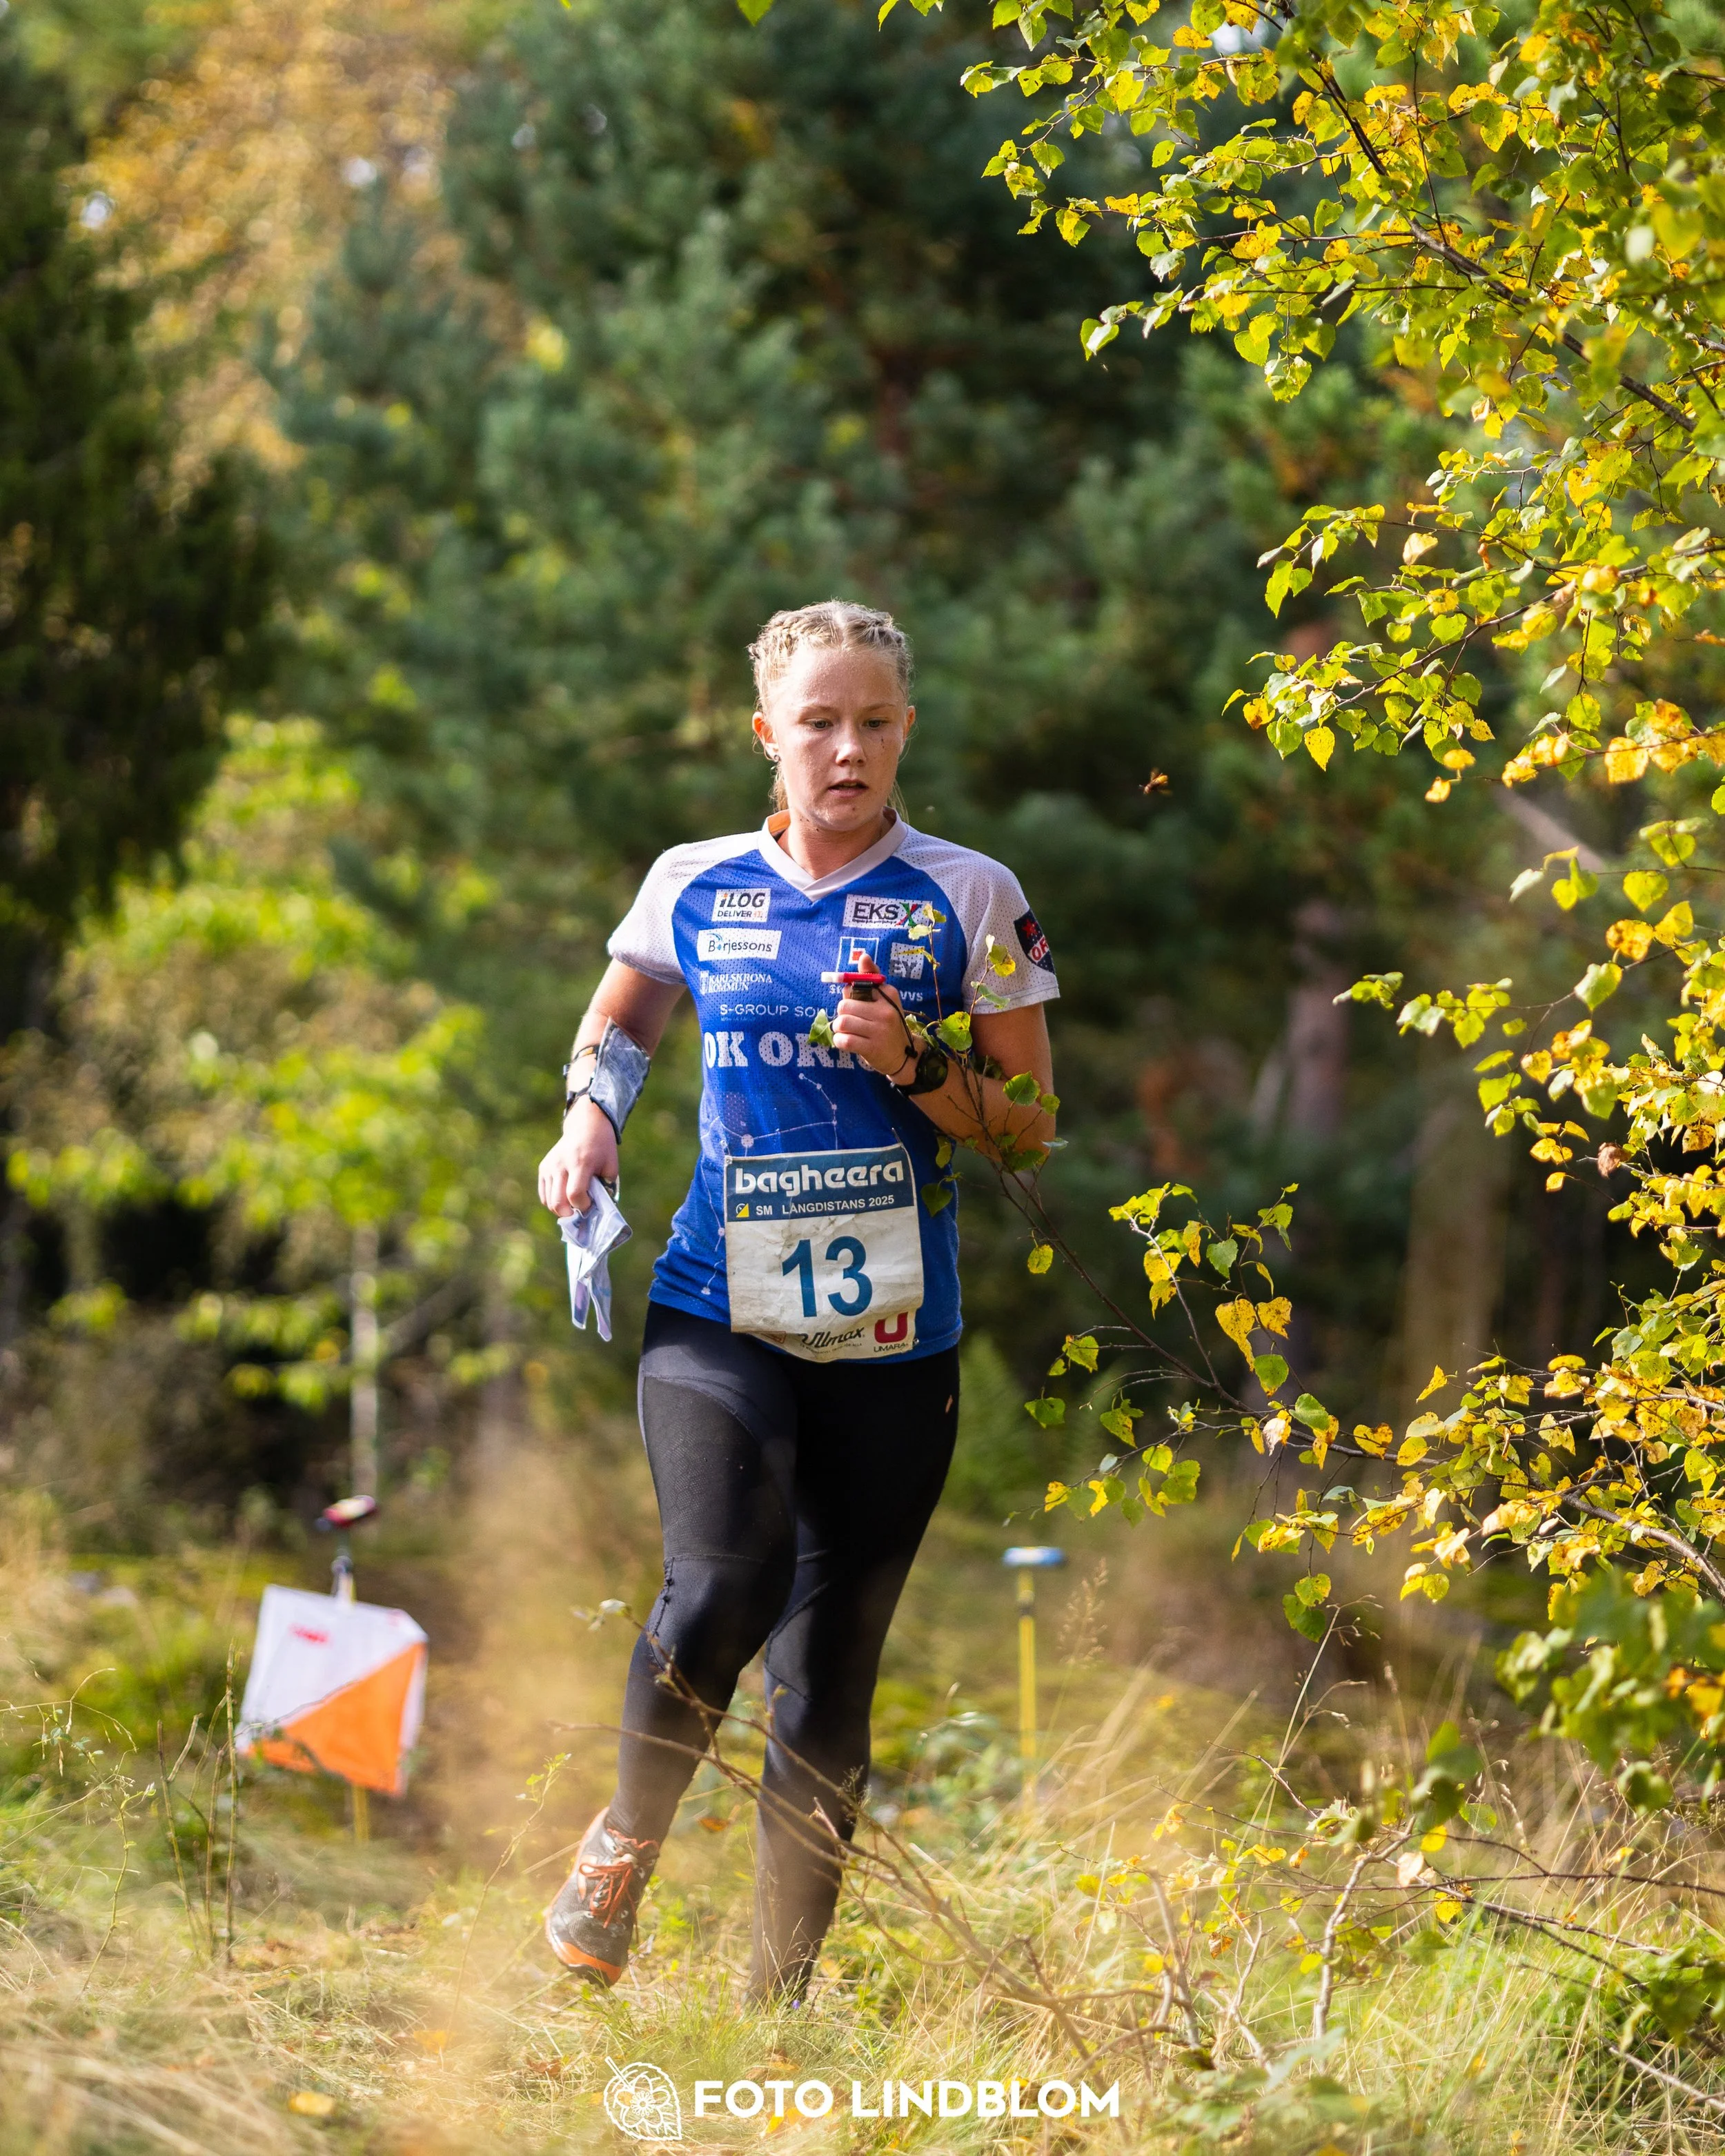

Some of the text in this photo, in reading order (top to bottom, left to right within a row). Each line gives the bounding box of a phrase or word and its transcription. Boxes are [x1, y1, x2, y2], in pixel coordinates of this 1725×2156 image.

[889, 959, 918, 978] EY
[708, 973, 773, 984] KARLSKRONA
[708, 981, 750, 993] KOMMUN
[720, 1004, 789, 1016] S-GROUP
[704, 1031, 749, 1069] OK
[736, 1160, 905, 1197] bagheera
[756, 1205, 773, 1216] SM
[868, 1194, 895, 1207] 2025
[781, 1235, 873, 1318] 13
[874, 1343, 907, 1353] UMARA
